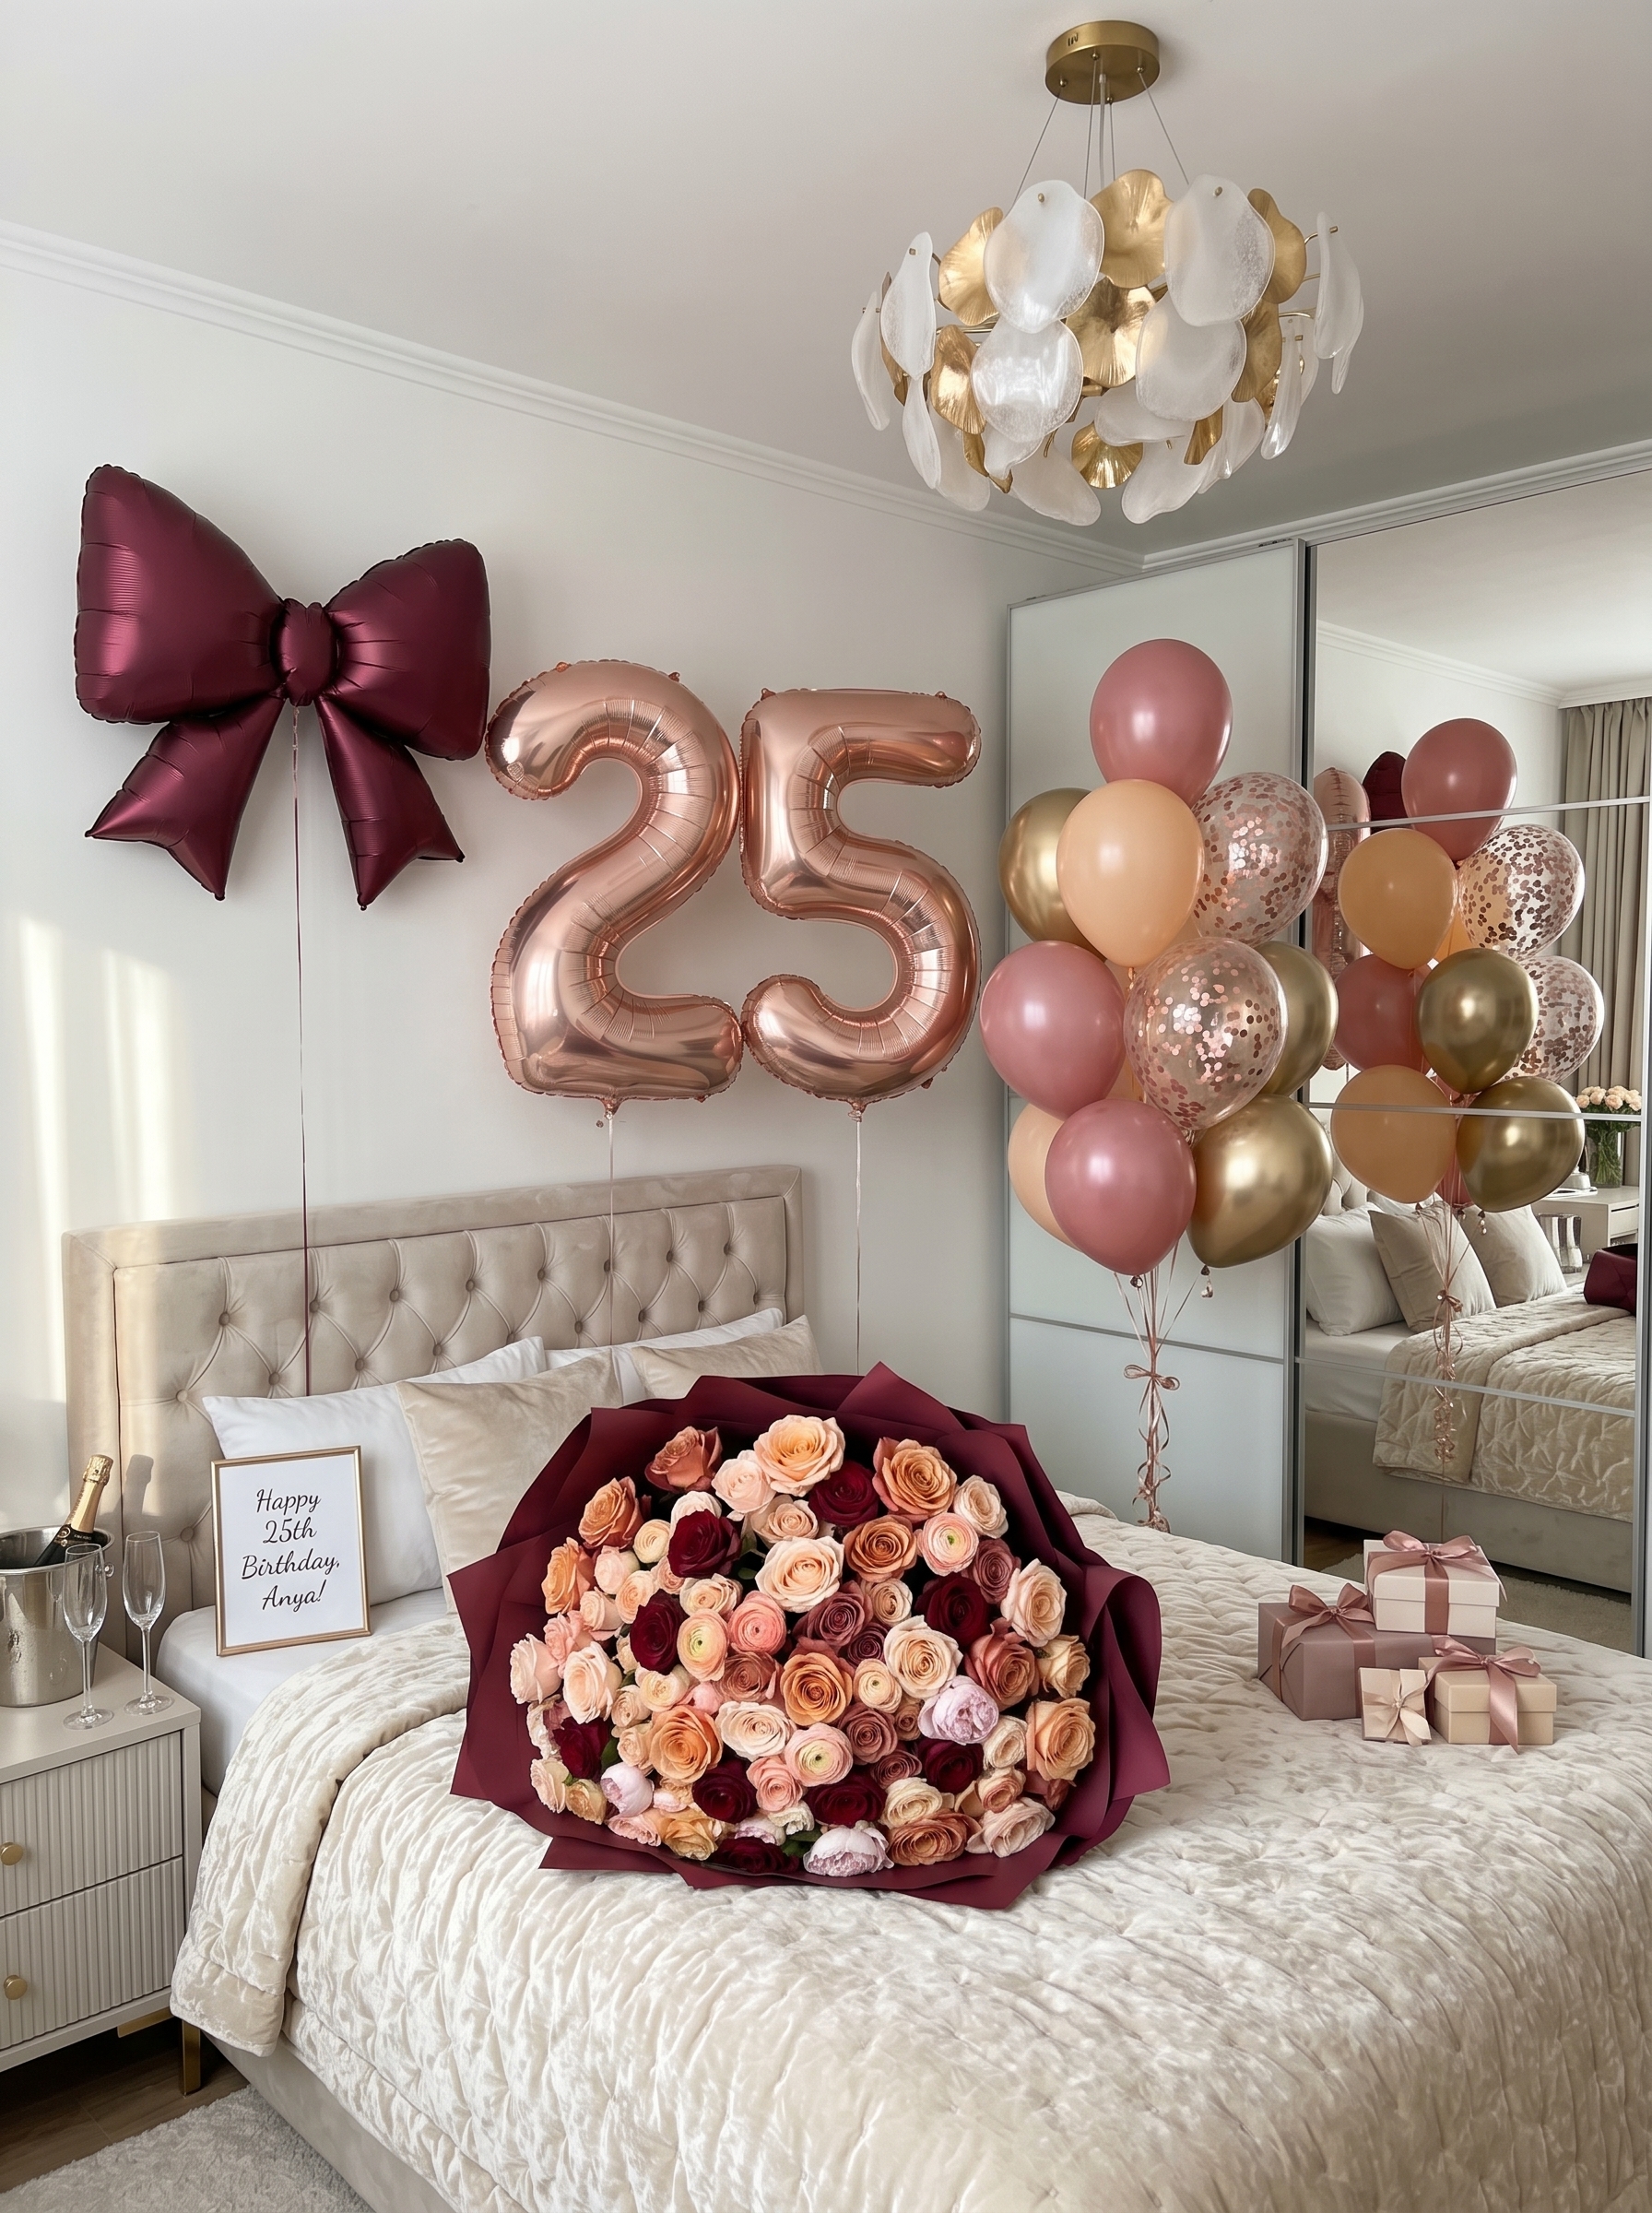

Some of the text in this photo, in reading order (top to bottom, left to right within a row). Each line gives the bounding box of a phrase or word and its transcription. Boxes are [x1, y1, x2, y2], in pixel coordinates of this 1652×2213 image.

[484, 659, 981, 1103] 25
[256, 1488, 321, 1515] Happy
[263, 1517, 317, 1544] 25th
[242, 1548, 340, 1580] Birthday,
[262, 1580, 326, 1612] Anya!
